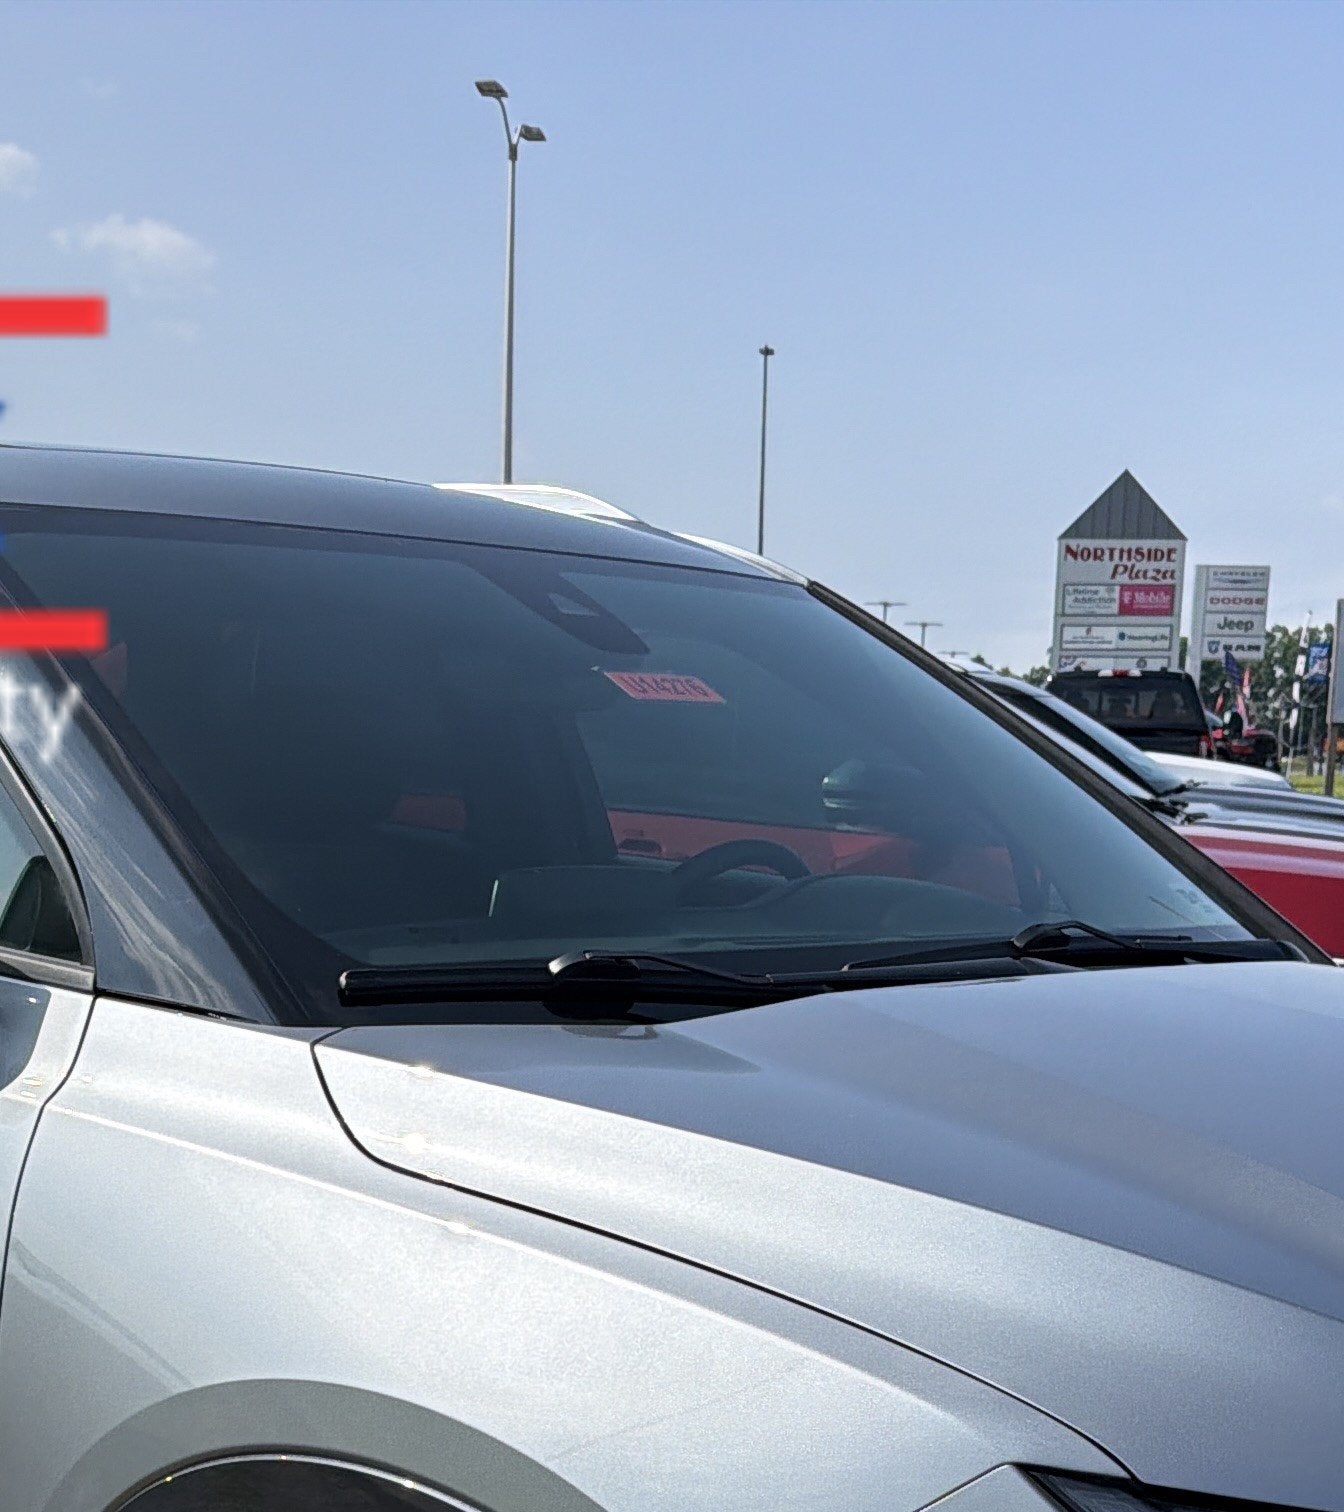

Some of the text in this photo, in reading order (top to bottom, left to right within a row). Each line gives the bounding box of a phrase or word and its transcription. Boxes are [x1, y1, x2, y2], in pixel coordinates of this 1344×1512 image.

[1065, 544, 1177, 562] NORTHSIDE
[1110, 563, 1176, 581] Plaza
[1209, 597, 1266, 606] DODGE
[1217, 616, 1255, 632] Jeep
